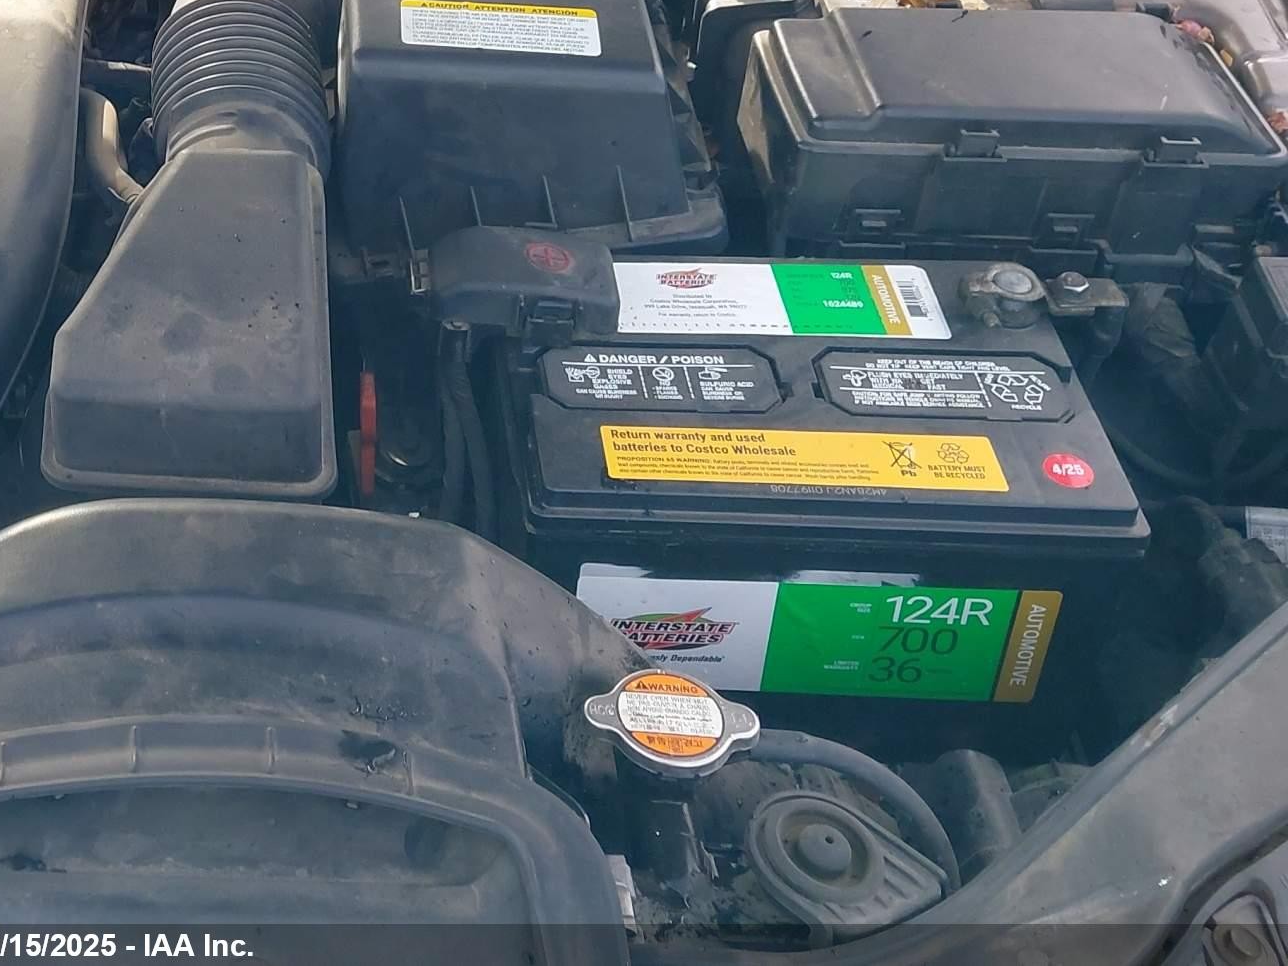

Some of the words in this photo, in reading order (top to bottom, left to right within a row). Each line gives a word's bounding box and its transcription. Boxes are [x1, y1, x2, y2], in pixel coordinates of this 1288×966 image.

[429, 2, 469, 10] CAUTION
[475, 5, 526, 13] ATTENTION
[532, 8, 578, 16] ATENCION
[872, 274, 900, 325] AUTOMOTIVE
[599, 354, 657, 363] DANGER
[659, 355, 668, 364] /
[671, 355, 724, 364] POISON
[610, 429, 651, 439] Return
[654, 430, 706, 443] warranty
[710, 431, 730, 442] and
[733, 432, 765, 443] used
[613, 442, 667, 453] batteries
[671, 443, 682, 453] to
[686, 444, 729, 455] Costco
[732, 445, 797, 456] Wholesale
[928, 465, 962, 473] BATTERY
[1051, 463, 1085, 476] 4/25
[886, 595, 993, 625] 124R
[612, 620, 733, 633] INTERSTATE
[877, 626, 958, 655] 700
[1010, 604, 1047, 686] AUTOMOTIVE
[671, 654, 722, 663] Dependable
[868, 656, 922, 683] 36
[647, 683, 698, 694] WARNING
